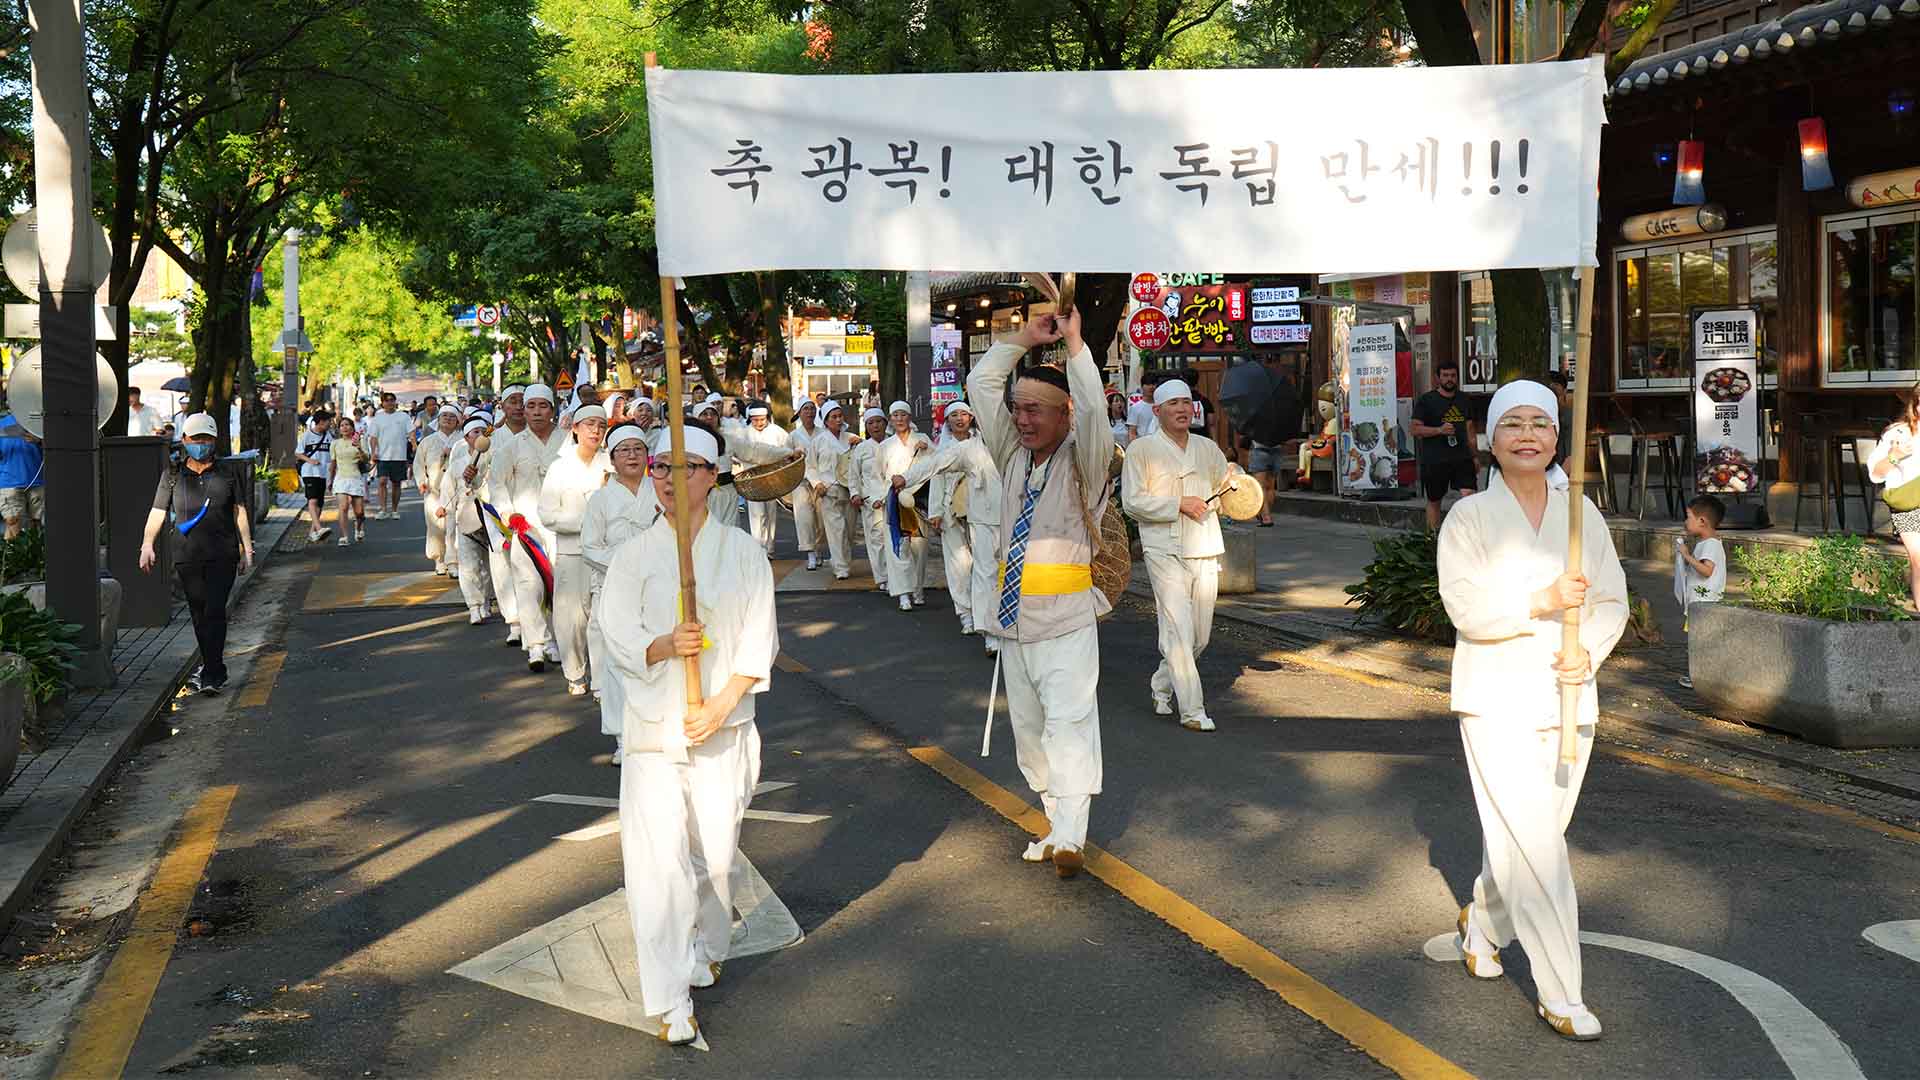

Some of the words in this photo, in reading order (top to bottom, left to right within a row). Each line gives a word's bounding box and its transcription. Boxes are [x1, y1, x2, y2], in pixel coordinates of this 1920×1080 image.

[710, 139, 773, 204] 축
[801, 136, 951, 203] 광복!
[1004, 140, 1133, 207] 대한
[1159, 140, 1279, 208] 독립
[1320, 136, 1529, 206] 만세!!!
[1646, 217, 1680, 236] CAFE
[1702, 320, 1749, 333] 한옥마을
[1465, 336, 1497, 357] TAK
[1469, 359, 1498, 381] OU
[1723, 428, 1732, 436] 맛
